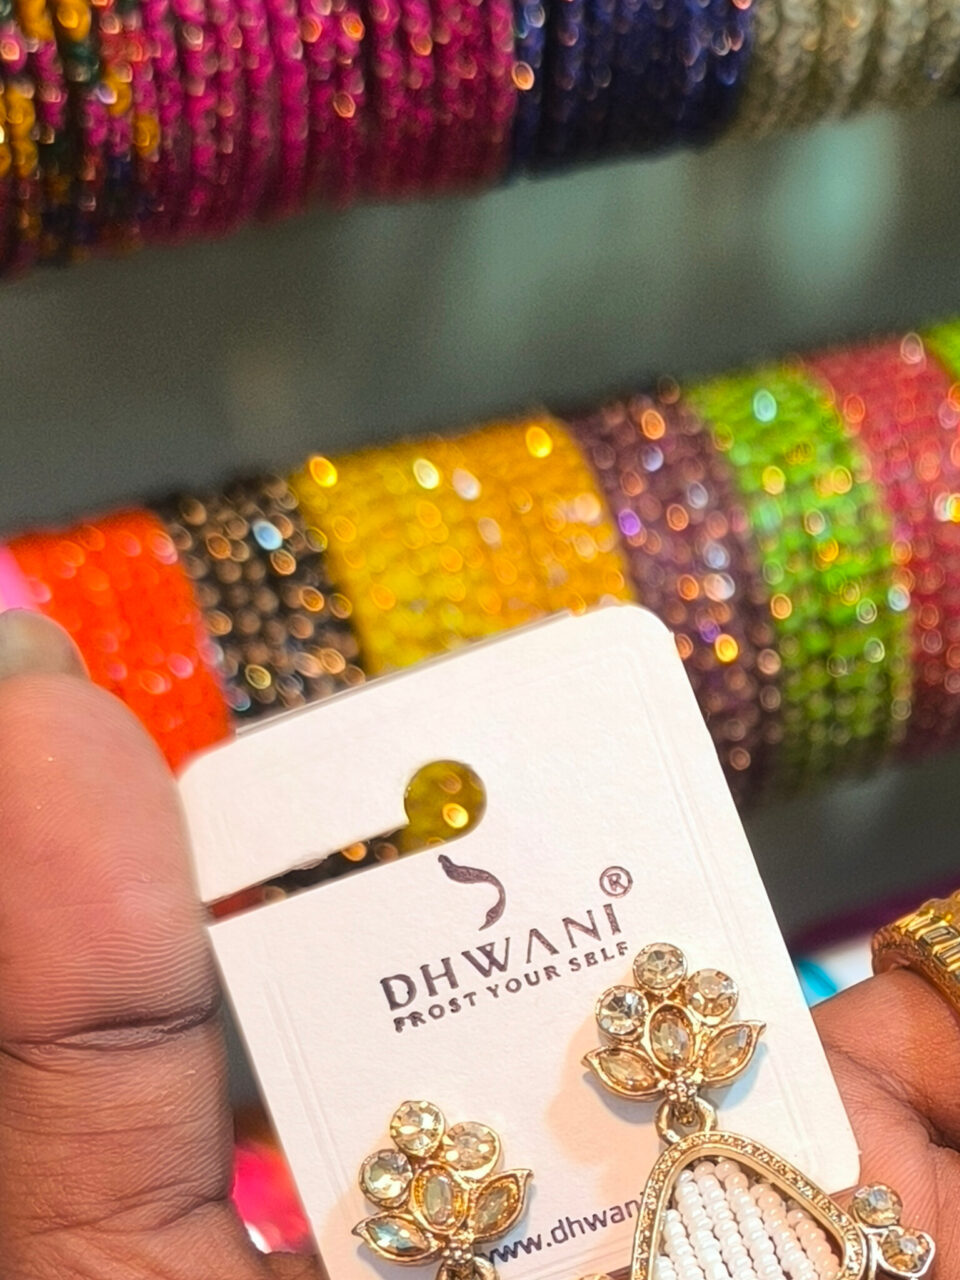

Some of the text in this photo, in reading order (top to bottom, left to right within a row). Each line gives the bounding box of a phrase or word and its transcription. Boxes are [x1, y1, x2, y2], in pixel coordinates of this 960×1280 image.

[380, 903, 622, 1011] DHWANI
[393, 941, 629, 1033] FROST YOUR SELF
[479, 1191, 644, 1264] ww.dhwan
